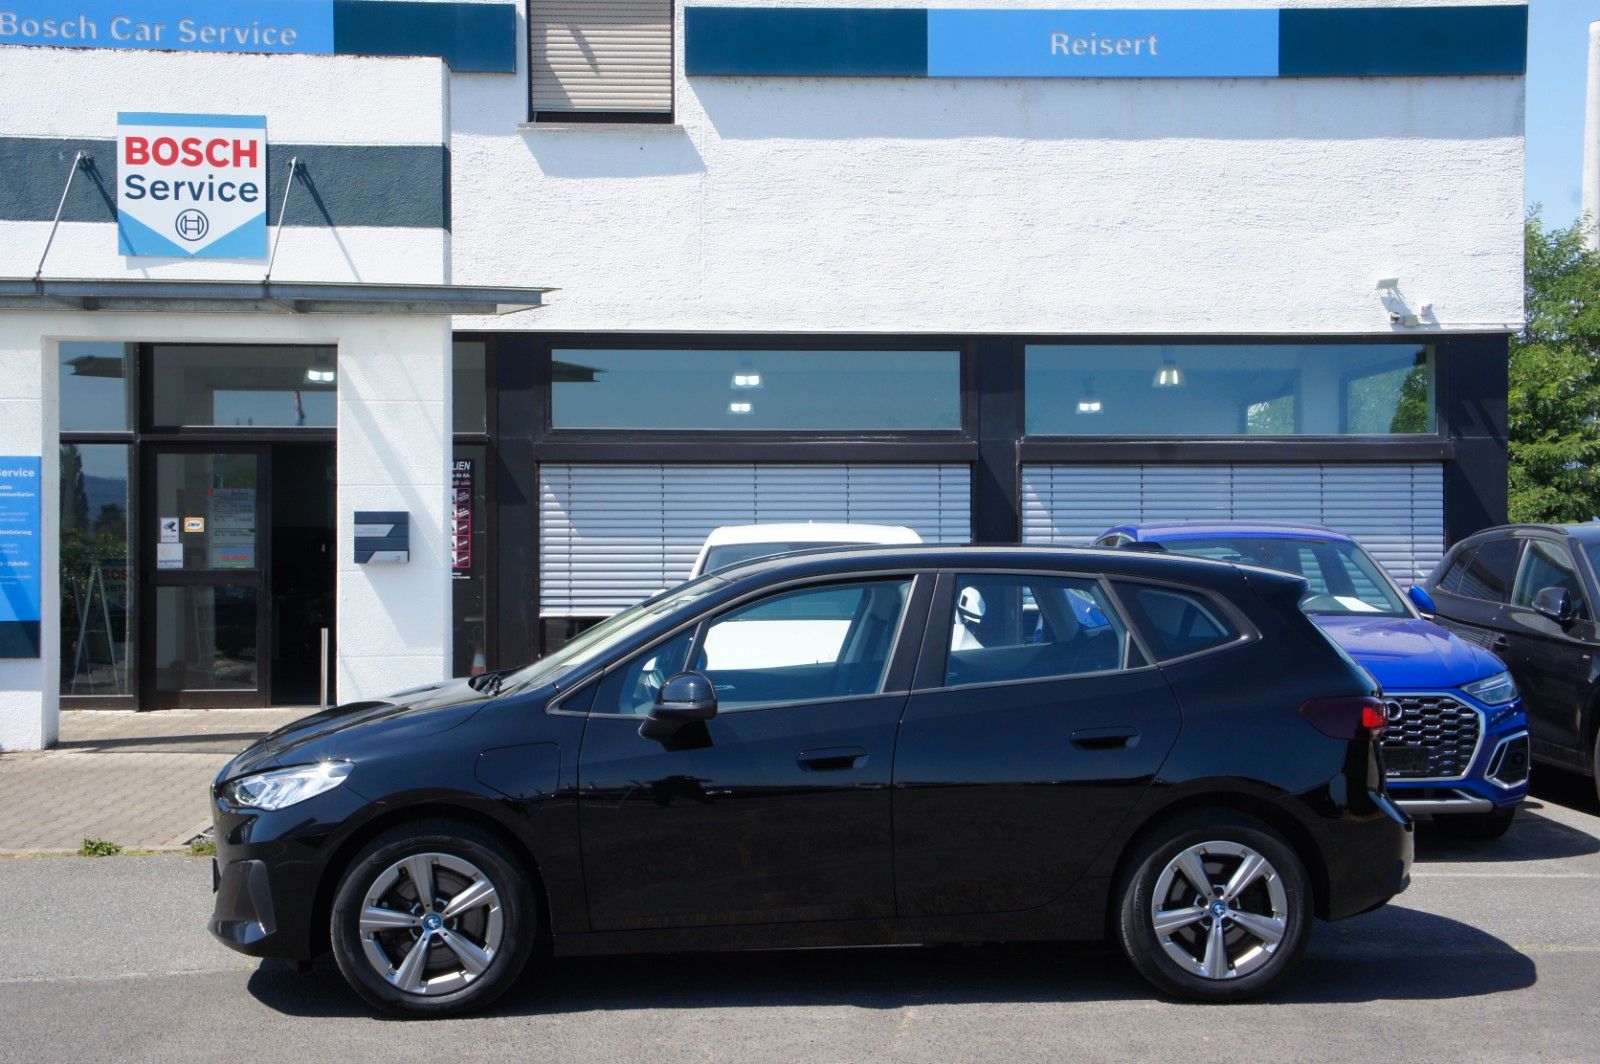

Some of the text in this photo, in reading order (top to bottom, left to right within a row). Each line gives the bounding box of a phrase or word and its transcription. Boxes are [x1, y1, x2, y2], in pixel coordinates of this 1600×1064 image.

[0, 11, 298, 46] Bosch Car Service
[1051, 32, 1159, 56] Reisert
[125, 136, 258, 168] BOSCH
[124, 174, 259, 203] Service
[0, 468, 35, 477] ervice
